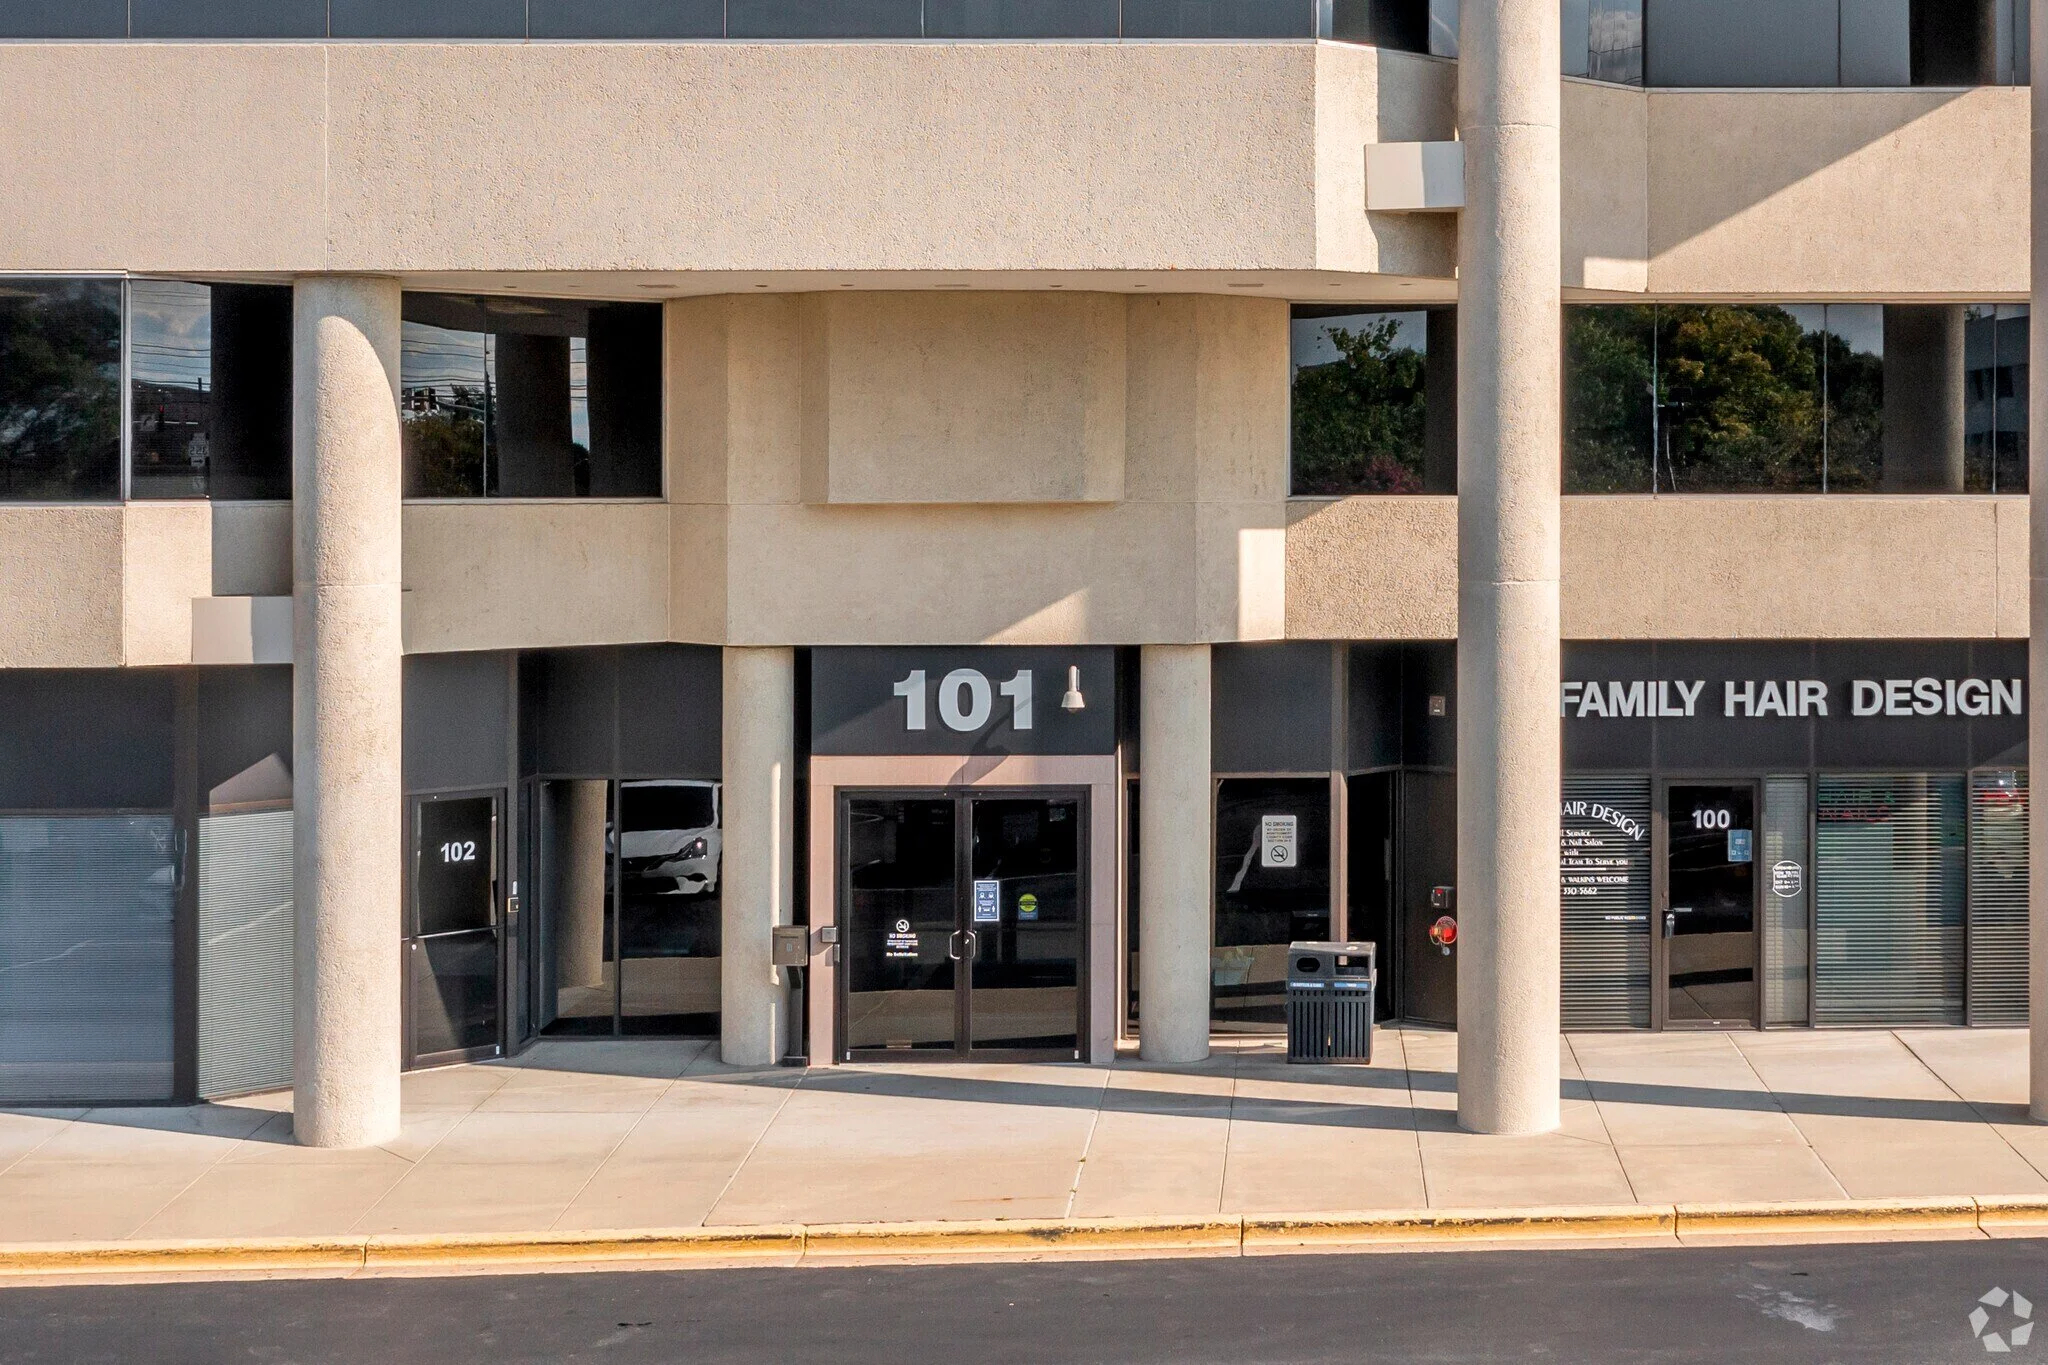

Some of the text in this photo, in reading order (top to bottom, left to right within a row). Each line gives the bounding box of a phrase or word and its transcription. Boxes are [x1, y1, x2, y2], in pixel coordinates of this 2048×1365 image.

[893, 668, 1033, 732] 101
[1560, 677, 2022, 718] FAMILY HAIR DESIGN
[1560, 801, 1645, 841] AIR DESIGN
[1691, 809, 1730, 829] 100
[440, 841, 476, 863] 102
[1597, 876, 1630, 884] WELCOME
